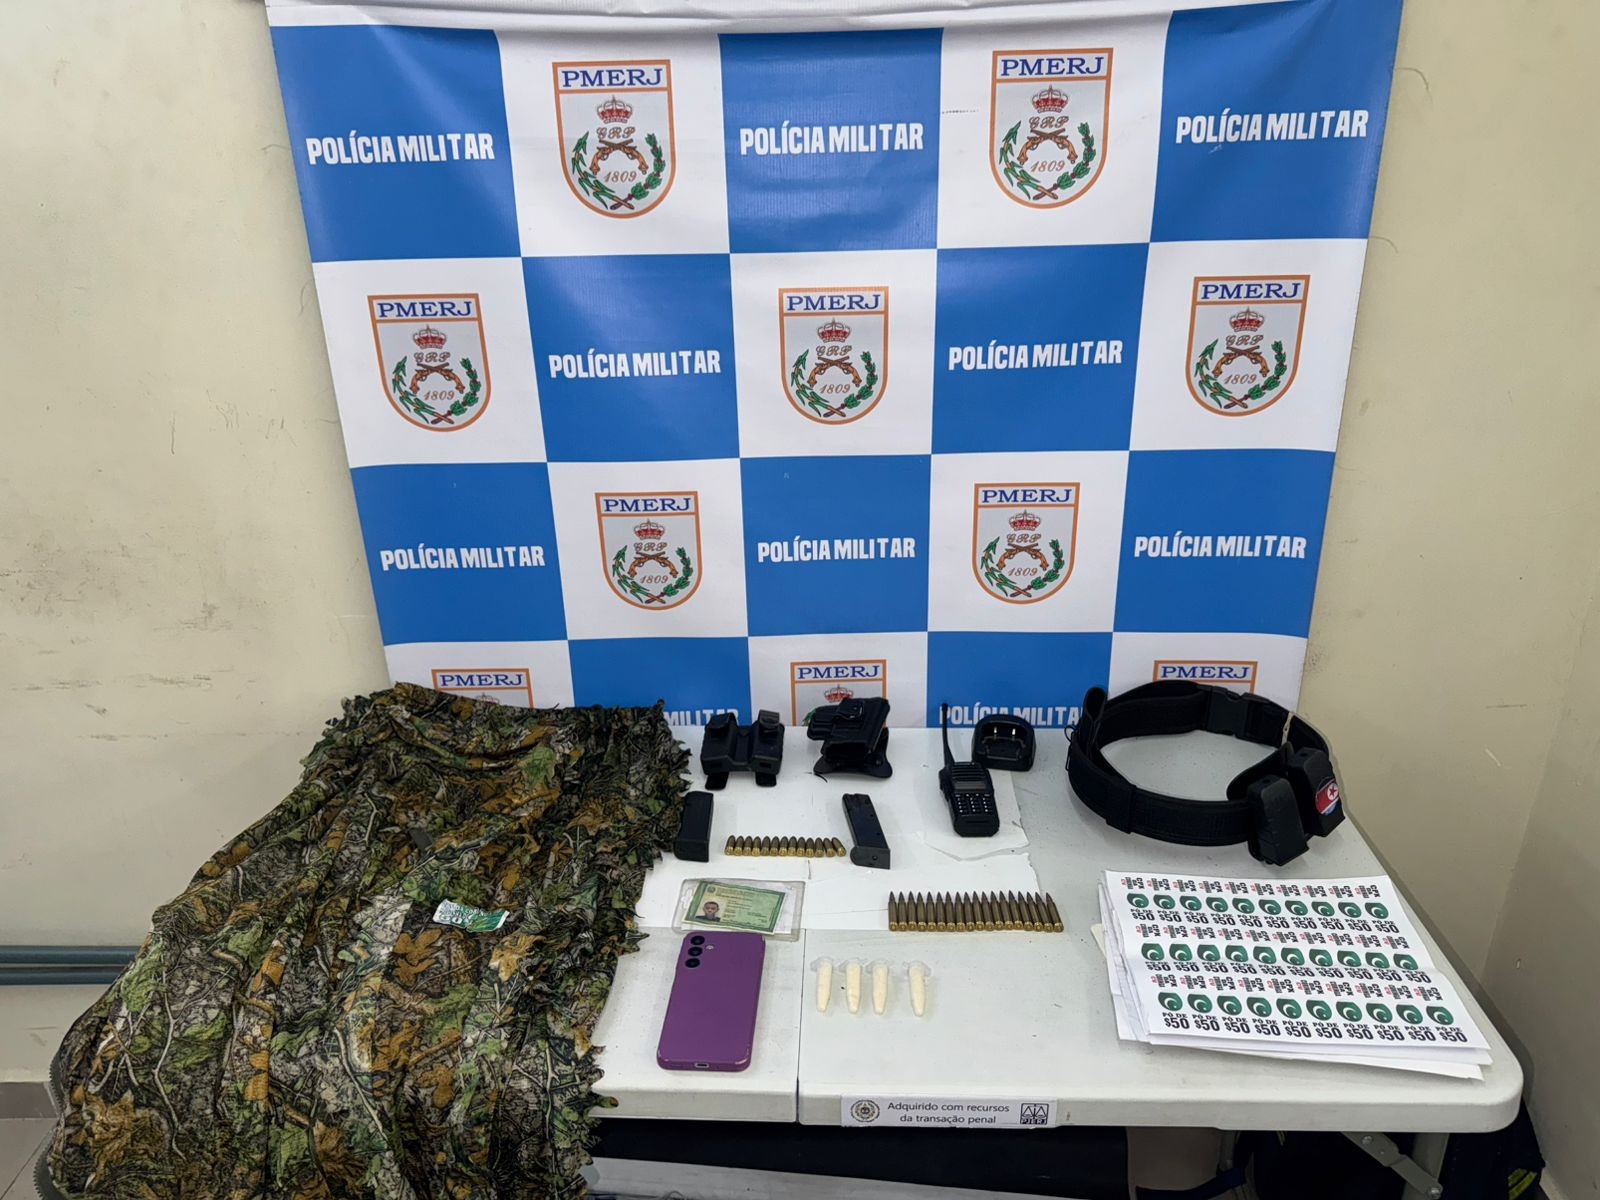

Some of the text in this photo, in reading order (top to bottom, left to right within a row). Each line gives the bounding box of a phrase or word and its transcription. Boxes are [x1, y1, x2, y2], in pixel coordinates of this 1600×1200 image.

[1000, 57, 1104, 76] PMERJ
[561, 68, 663, 88] PMERJ
[1175, 108, 1368, 144] POLÍCIA MILITAR
[739, 120, 924, 155] POLÍCIA MILITAR
[306, 131, 496, 165] POLÍCIA MILITAR
[1031, 161, 1065, 172] 1809
[604, 171, 637, 182] 1809
[1201, 283, 1301, 299] PMERJ
[787, 294, 881, 311] PMERJ
[377, 301, 472, 318] PMERJ
[948, 339, 1122, 370] POLÍCIA MILITAR
[548, 348, 721, 378] POLÍCIA MILITAR
[1224, 374, 1256, 384] 1809
[820, 384, 850, 394] 1809
[424, 391, 455, 400] 1809
[982, 489, 1072, 503] PMERJ
[603, 498, 691, 512] PMERJ
[758, 535, 915, 563] POLÍCIA MILITAR
[1134, 530, 1307, 559] POLÍCIA MILITAR
[380, 543, 545, 571] POLÍCIA MILITAR
[1008, 568, 1038, 576] 1809
[641, 576, 668, 584] 1809
[798, 665, 880, 680] PMERJ
[1161, 665, 1249, 679] PMERJ
[440, 674, 523, 687] PMERJ
[1012, 706, 1083, 726] MILITA
[1132, 912, 1155, 921] $50
[1159, 914, 1182, 922] $50
[1186, 915, 1208, 924] $50
[1213, 917, 1235, 926] $50
[1240, 918, 1262, 927] $50
[1266, 920, 1289, 928] $50
[1294, 921, 1317, 929] $50
[1321, 922, 1344, 930] $50
[1348, 923, 1372, 932] $50
[1375, 924, 1399, 933] $50
[1176, 964, 1200, 972] $50
[1204, 965, 1228, 973] $50
[1232, 966, 1257, 974] $50
[1261, 967, 1286, 975] $50
[1289, 969, 1315, 977] $50
[1319, 970, 1344, 978] $50
[1347, 971, 1373, 980] $50
[1377, 972, 1402, 981] $50
[1406, 973, 1431, 983] $50
[1165, 1018, 1189, 1029] $50
[1195, 1020, 1220, 1031] $50
[1225, 1022, 1250, 1033] $50
[1255, 1024, 1280, 1035] $50
[1285, 1026, 1311, 1038] $50
[1316, 1027, 1342, 1038] $50
[1347, 1028, 1373, 1039] $50
[1378, 1030, 1405, 1040] $50
[1408, 1031, 1436, 1041] $50
[1439, 1032, 1467, 1042] $50
[888, 1102, 938, 1112] Adquirido
[967, 1104, 1010, 1112] recursos
[900, 1114, 996, 1124] da transação penal
